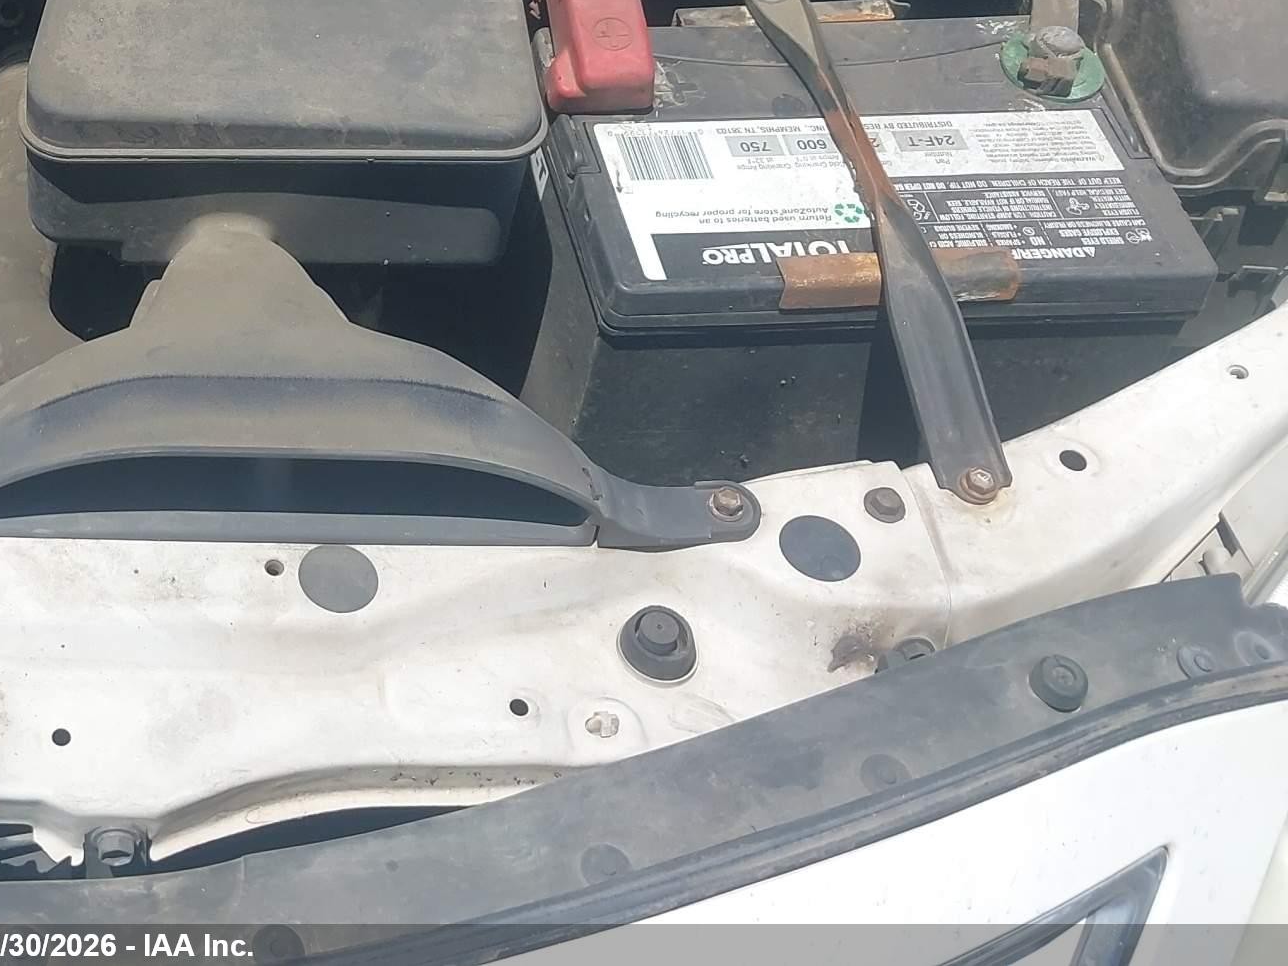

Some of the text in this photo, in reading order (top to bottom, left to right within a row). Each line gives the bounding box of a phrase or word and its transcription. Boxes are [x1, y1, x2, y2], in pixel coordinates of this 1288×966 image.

[897, 121, 952, 129] DISTRIBUTED
[797, 139, 827, 151] 600
[907, 135, 955, 147] 24F-T
[740, 141, 771, 152] 750
[655, 208, 699, 219] recycling
[701, 207, 735, 217] proper
[736, 209, 752, 217] for
[726, 216, 769, 224] batteries
[772, 214, 796, 223] used
[799, 214, 832, 223] Return
[1029, 236, 1047, 245] NO
